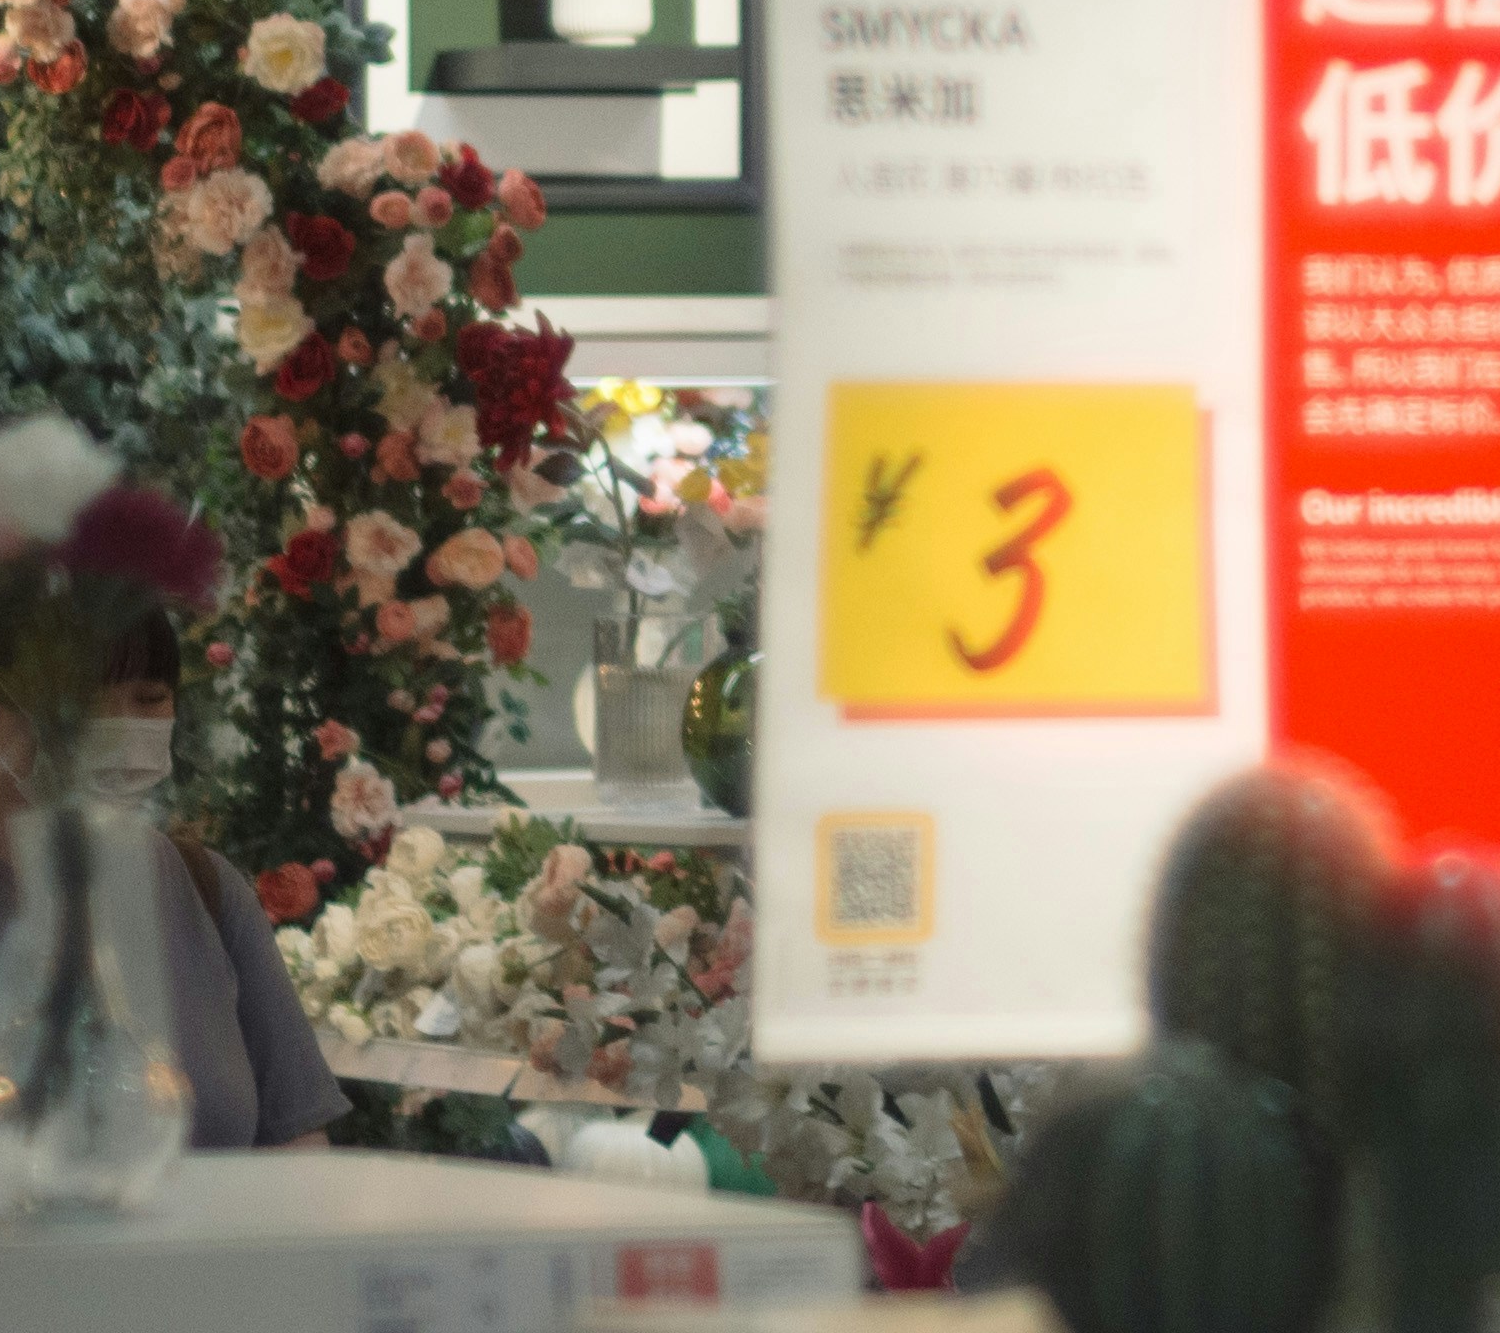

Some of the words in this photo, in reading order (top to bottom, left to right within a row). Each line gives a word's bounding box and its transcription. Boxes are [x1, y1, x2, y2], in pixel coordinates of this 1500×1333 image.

[821, 8, 1032, 53] SMYCKA
[1300, 488, 1363, 526] Our
[947, 467, 1074, 673] 3
